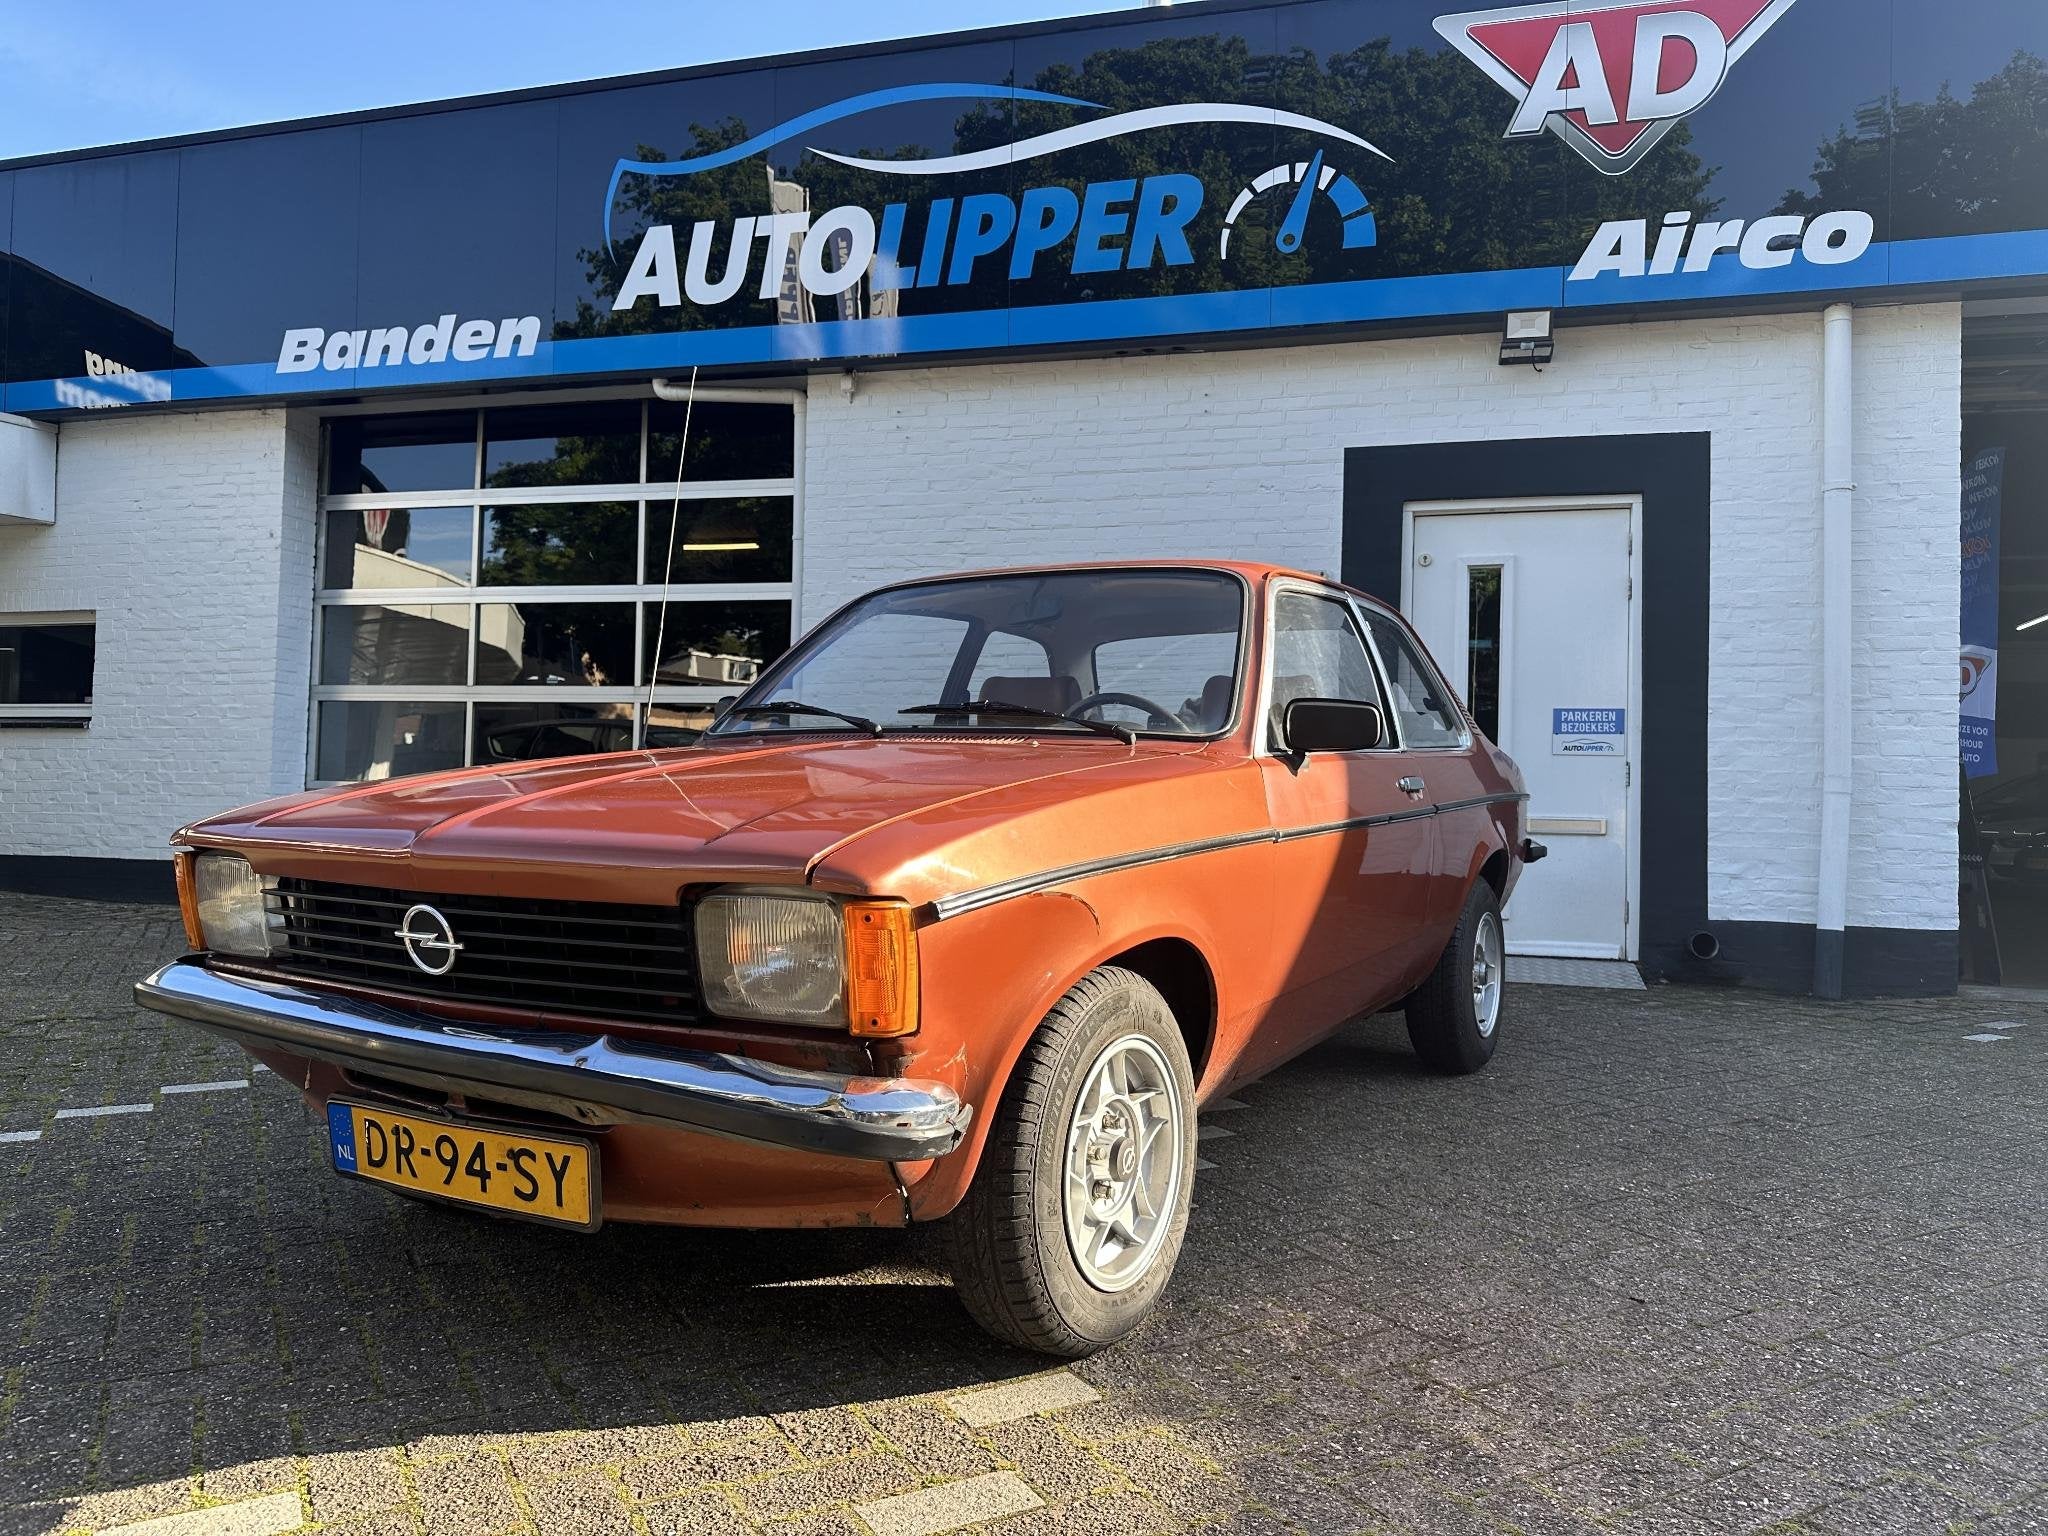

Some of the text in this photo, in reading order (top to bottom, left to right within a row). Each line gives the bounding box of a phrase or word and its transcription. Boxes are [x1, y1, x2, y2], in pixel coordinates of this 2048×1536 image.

[1504, 10, 1728, 137] AD
[611, 173, 1203, 311] AUTOLIPPER
[1567, 210, 1874, 281] Airco
[275, 314, 541, 375] Banden
[1561, 711, 1616, 722] PARKEREN
[1561, 722, 1616, 733] BEZOEKERS
[1959, 724, 1971, 734] ZE
[337, 1143, 354, 1161] NL
[363, 1117, 572, 1208] DR-94-SY
